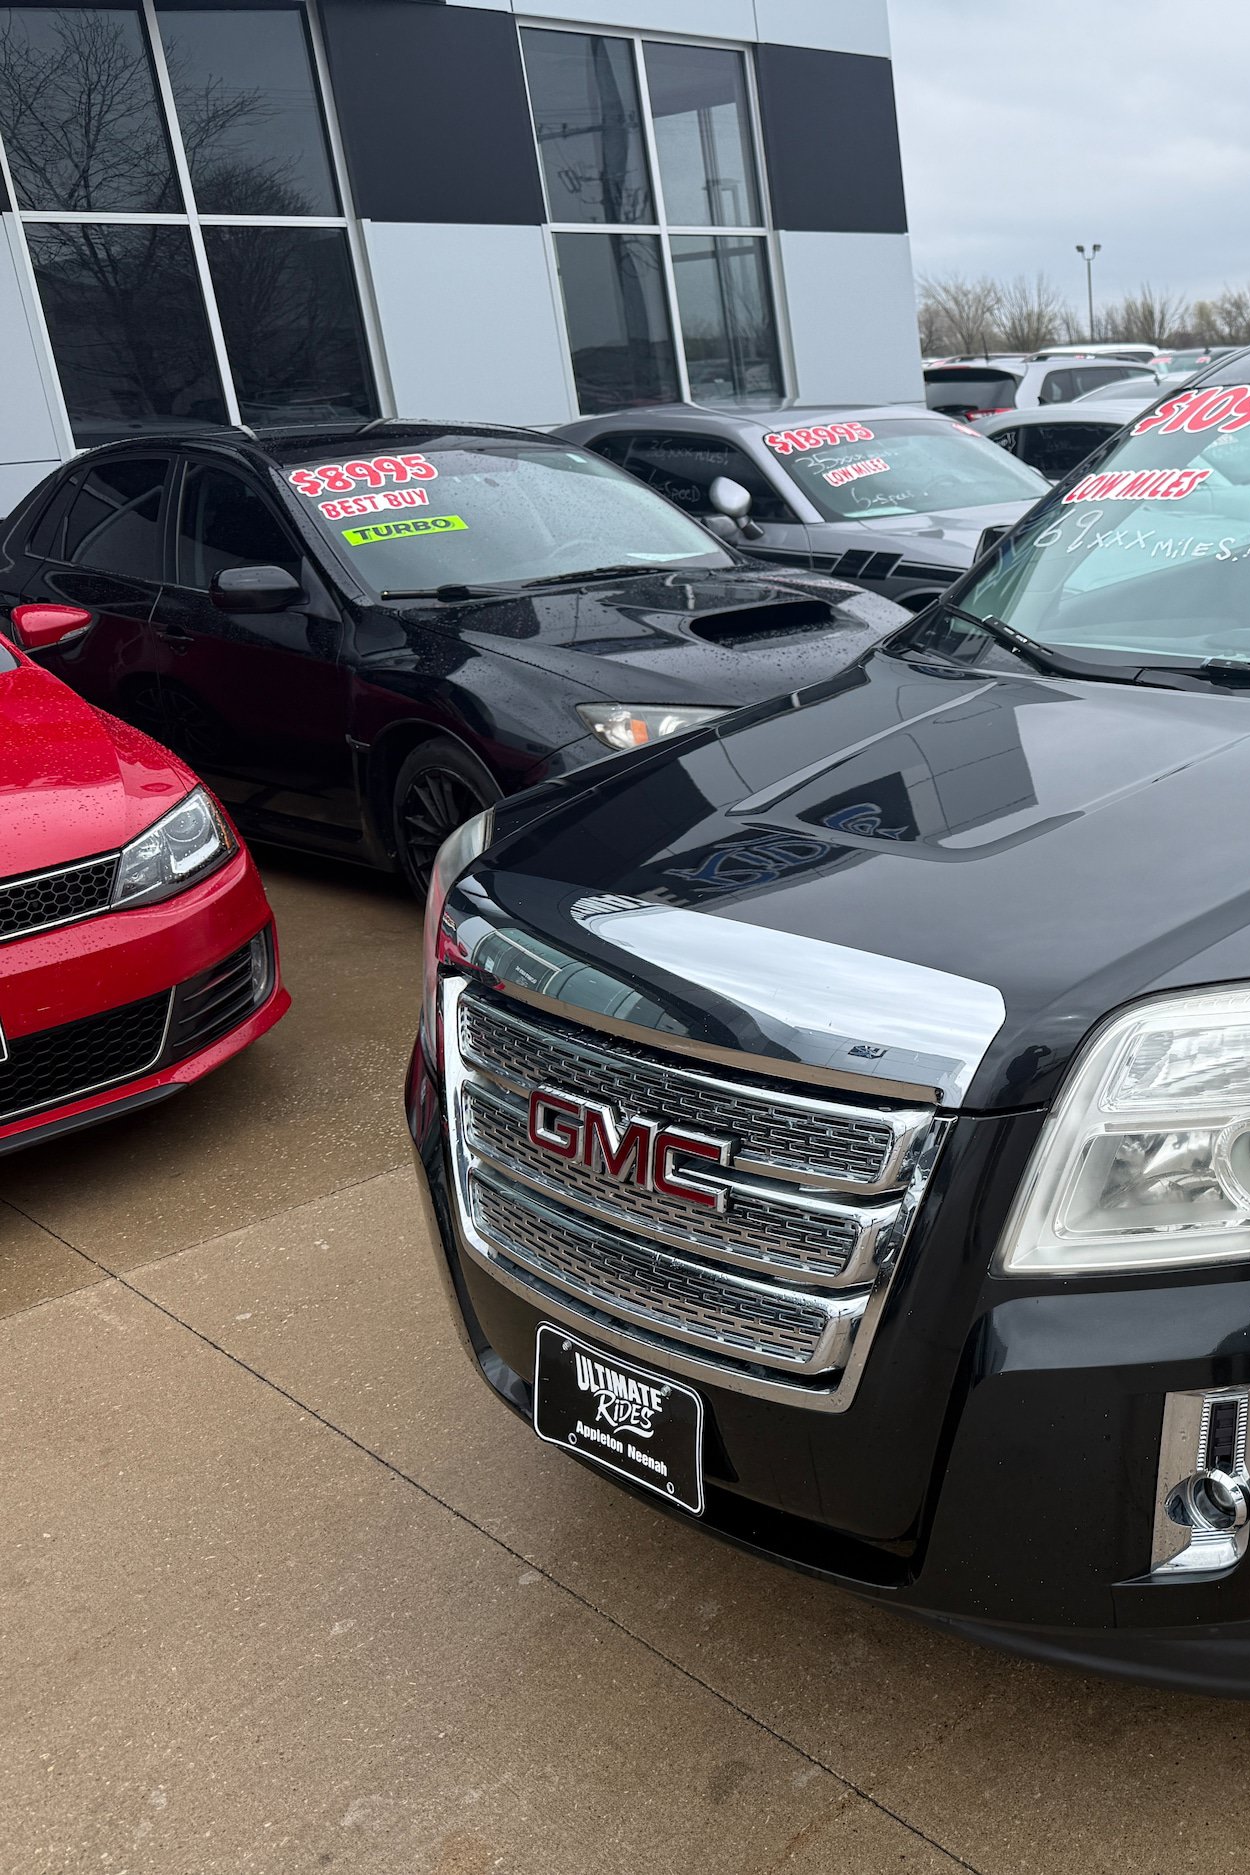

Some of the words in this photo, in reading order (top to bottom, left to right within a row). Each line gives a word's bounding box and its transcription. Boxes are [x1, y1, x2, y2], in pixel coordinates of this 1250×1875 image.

[765, 422, 875, 455] $18995
[289, 453, 438, 497] $8995
[822, 466, 857, 487] LOW
[852, 457, 891, 478] MILES
[1062, 472, 1127, 504] LOW
[1120, 468, 1214, 501] MILES
[318, 495, 382, 520] BEST
[382, 487, 430, 511] BUY
[353, 518, 451, 540] TURBO
[528, 1082, 732, 1213] GMC
[575, 1352, 662, 1412] ULTIMATE
[577, 1420, 624, 1453] Appleton
[627, 1444, 668, 1477] Neenah
